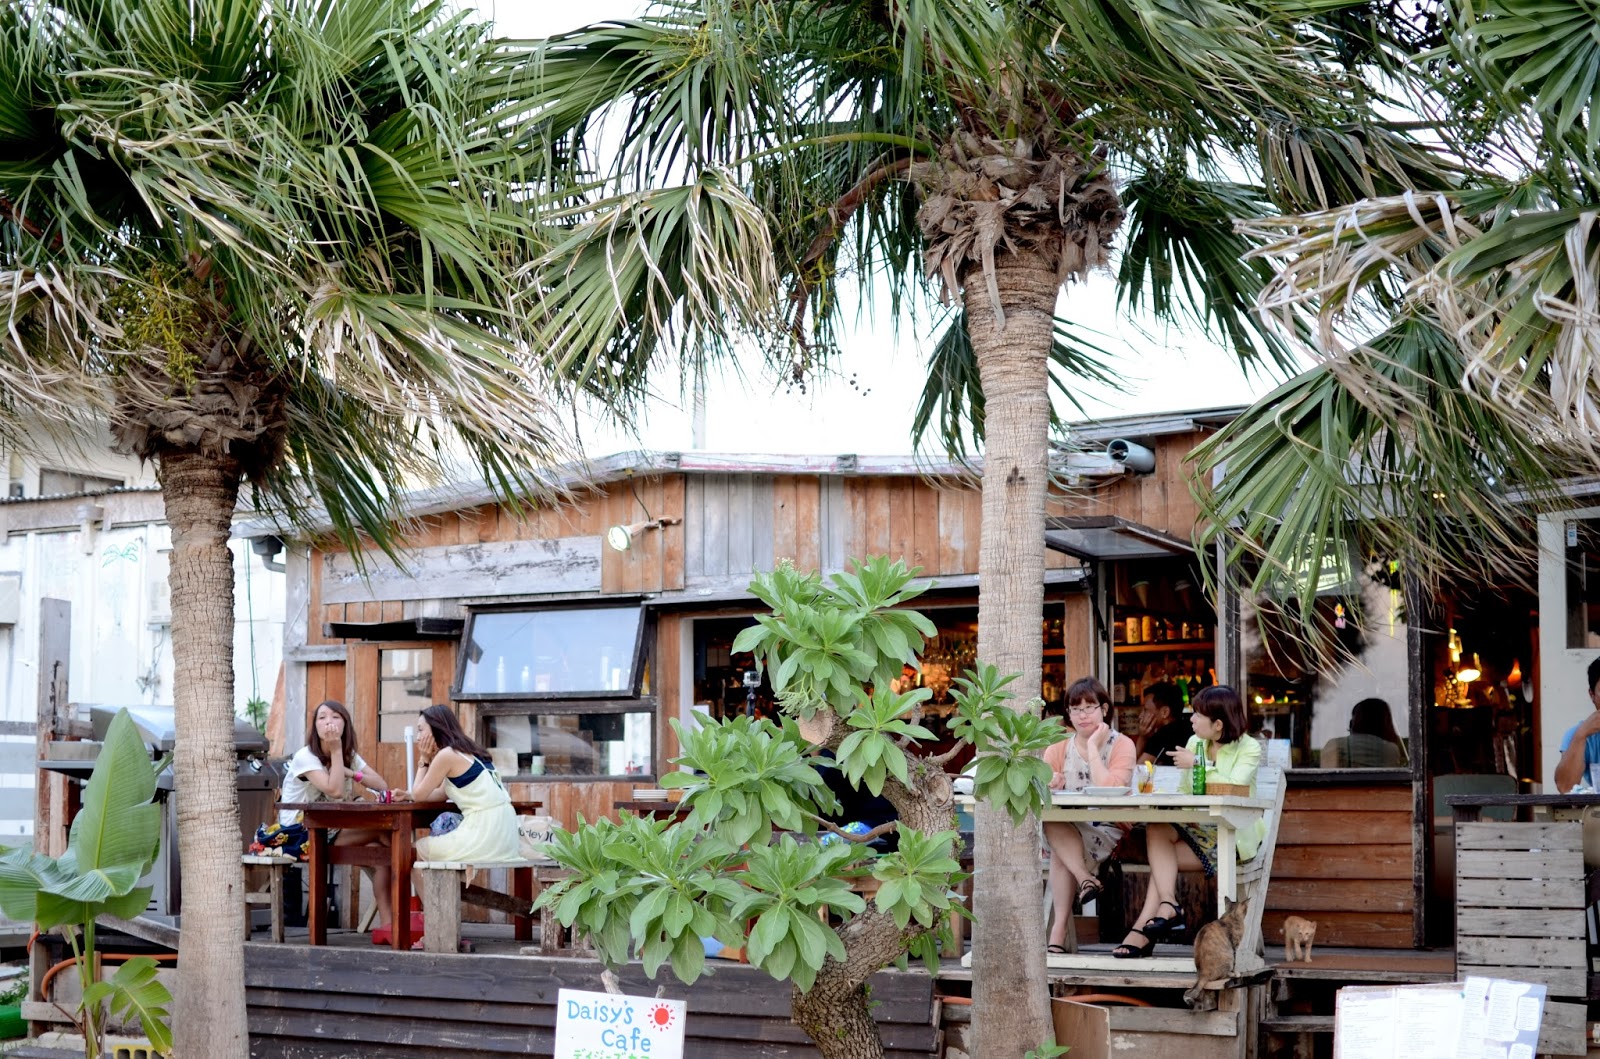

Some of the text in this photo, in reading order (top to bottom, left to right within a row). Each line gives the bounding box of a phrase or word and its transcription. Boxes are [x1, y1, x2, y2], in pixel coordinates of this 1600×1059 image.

[518, 826, 544, 841] urley
[567, 1000, 634, 1025] Daisy's
[601, 1027, 651, 1052] Cafe
